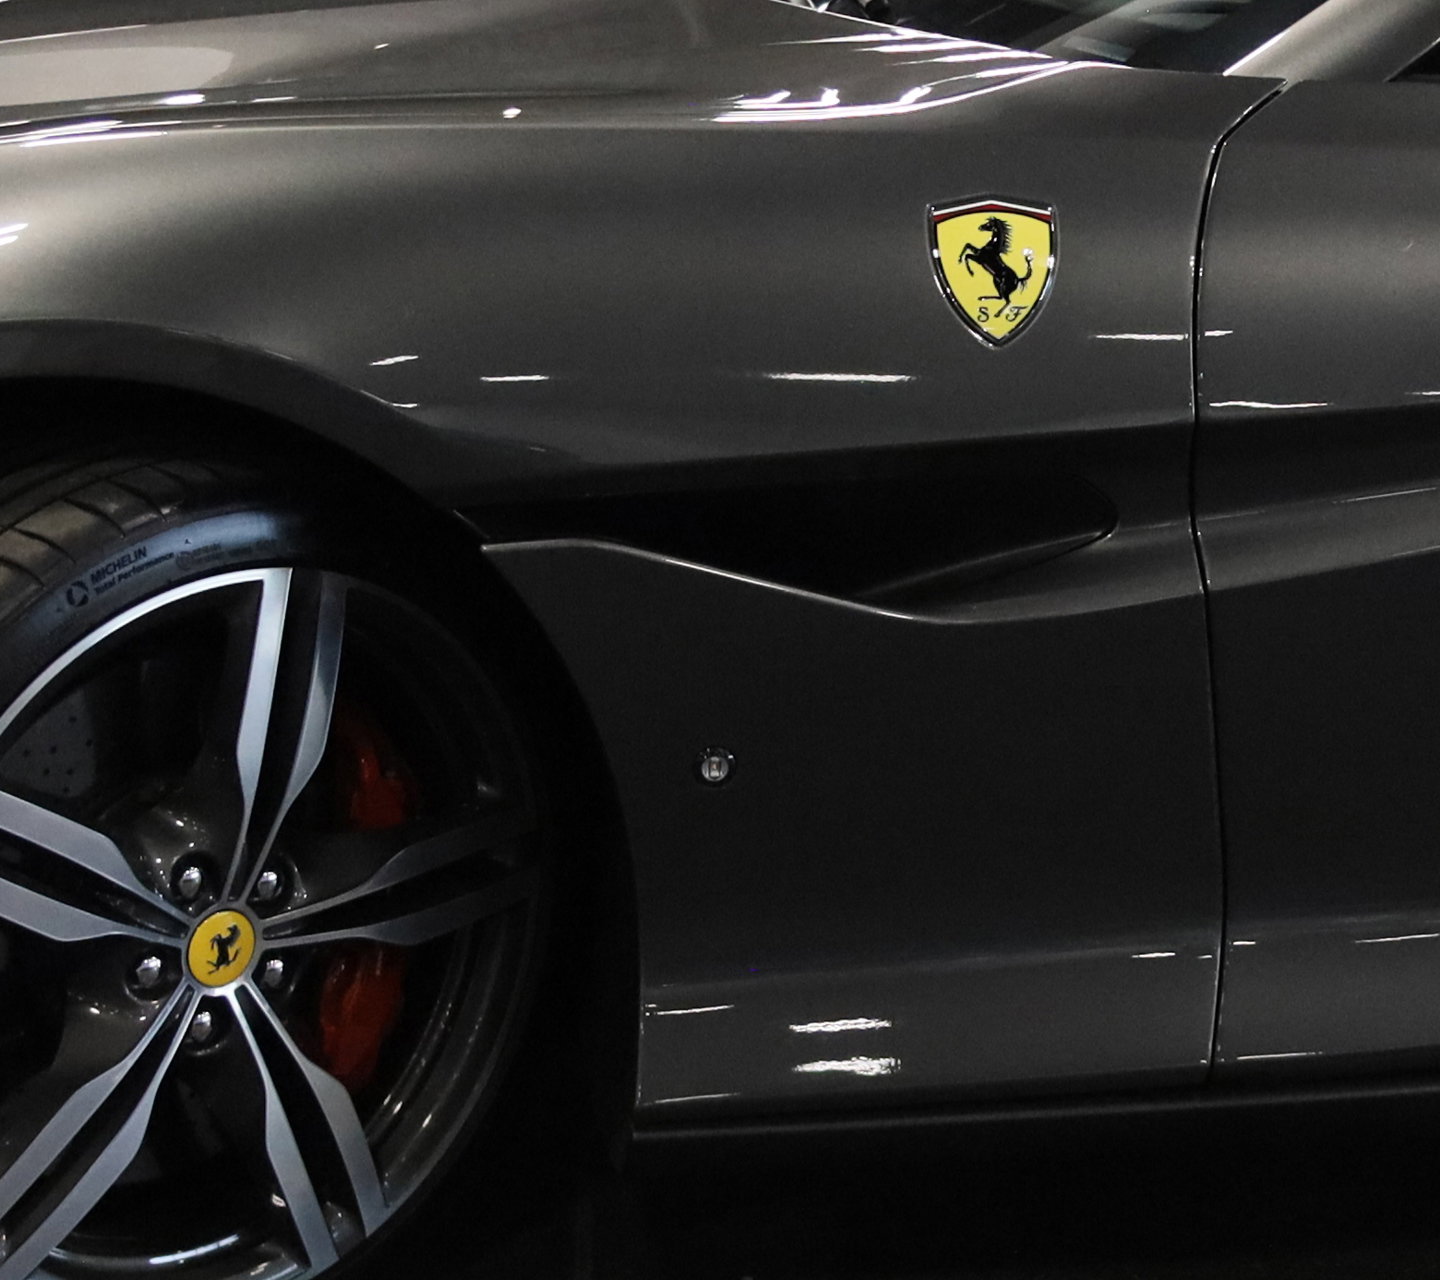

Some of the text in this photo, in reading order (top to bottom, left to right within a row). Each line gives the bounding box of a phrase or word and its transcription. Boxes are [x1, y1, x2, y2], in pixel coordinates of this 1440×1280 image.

[977, 306, 1028, 322] S F
[90, 546, 147, 584] MICHELIN
[94, 577, 116, 594] Total
[117, 552, 175, 582] Performance
